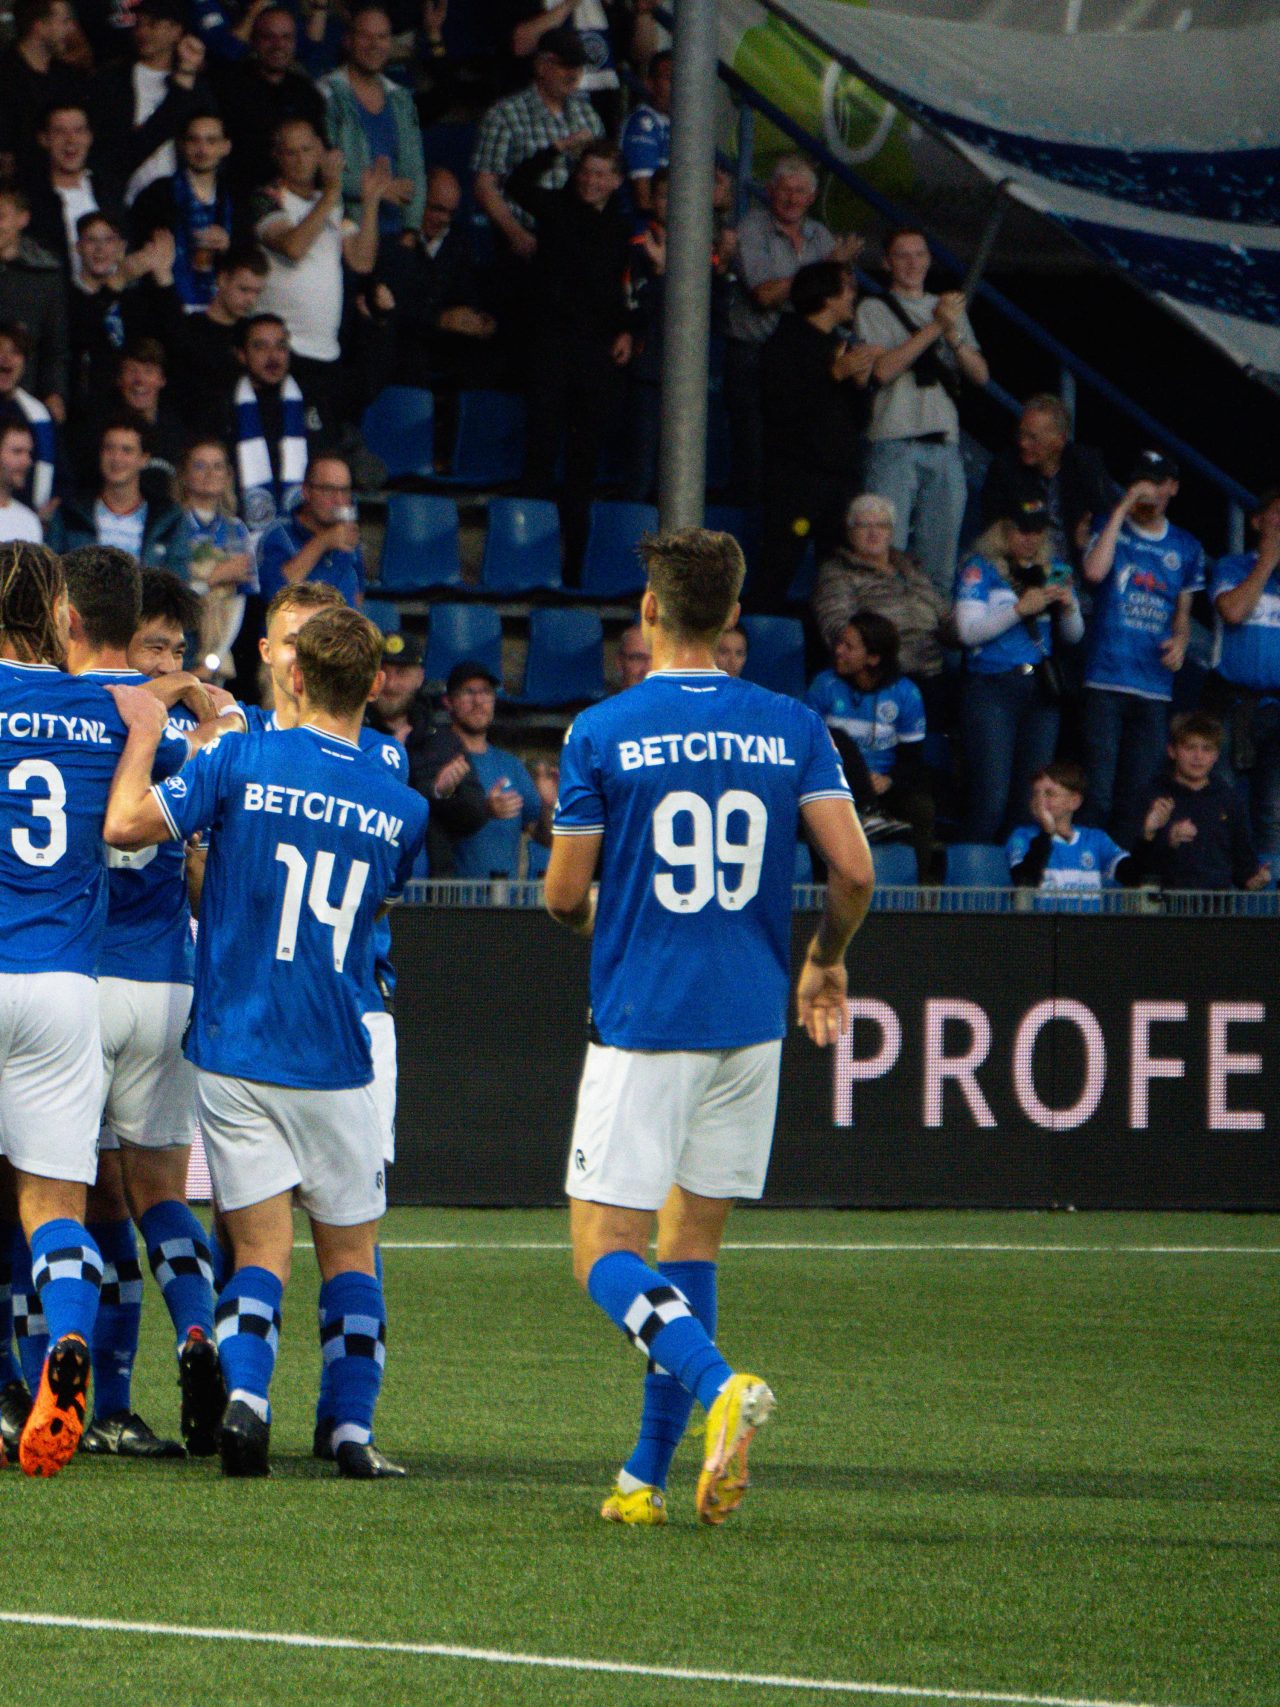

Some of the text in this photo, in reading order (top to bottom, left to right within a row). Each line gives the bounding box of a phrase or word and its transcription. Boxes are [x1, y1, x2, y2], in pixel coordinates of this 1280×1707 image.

[619, 731, 796, 771] BETCITY.NL
[8, 759, 67, 867] 3
[244, 782, 404, 848] BETCITY.NL
[653, 789, 768, 914] 99
[275, 842, 370, 974] 14
[831, 997, 1267, 1132] PROFE
